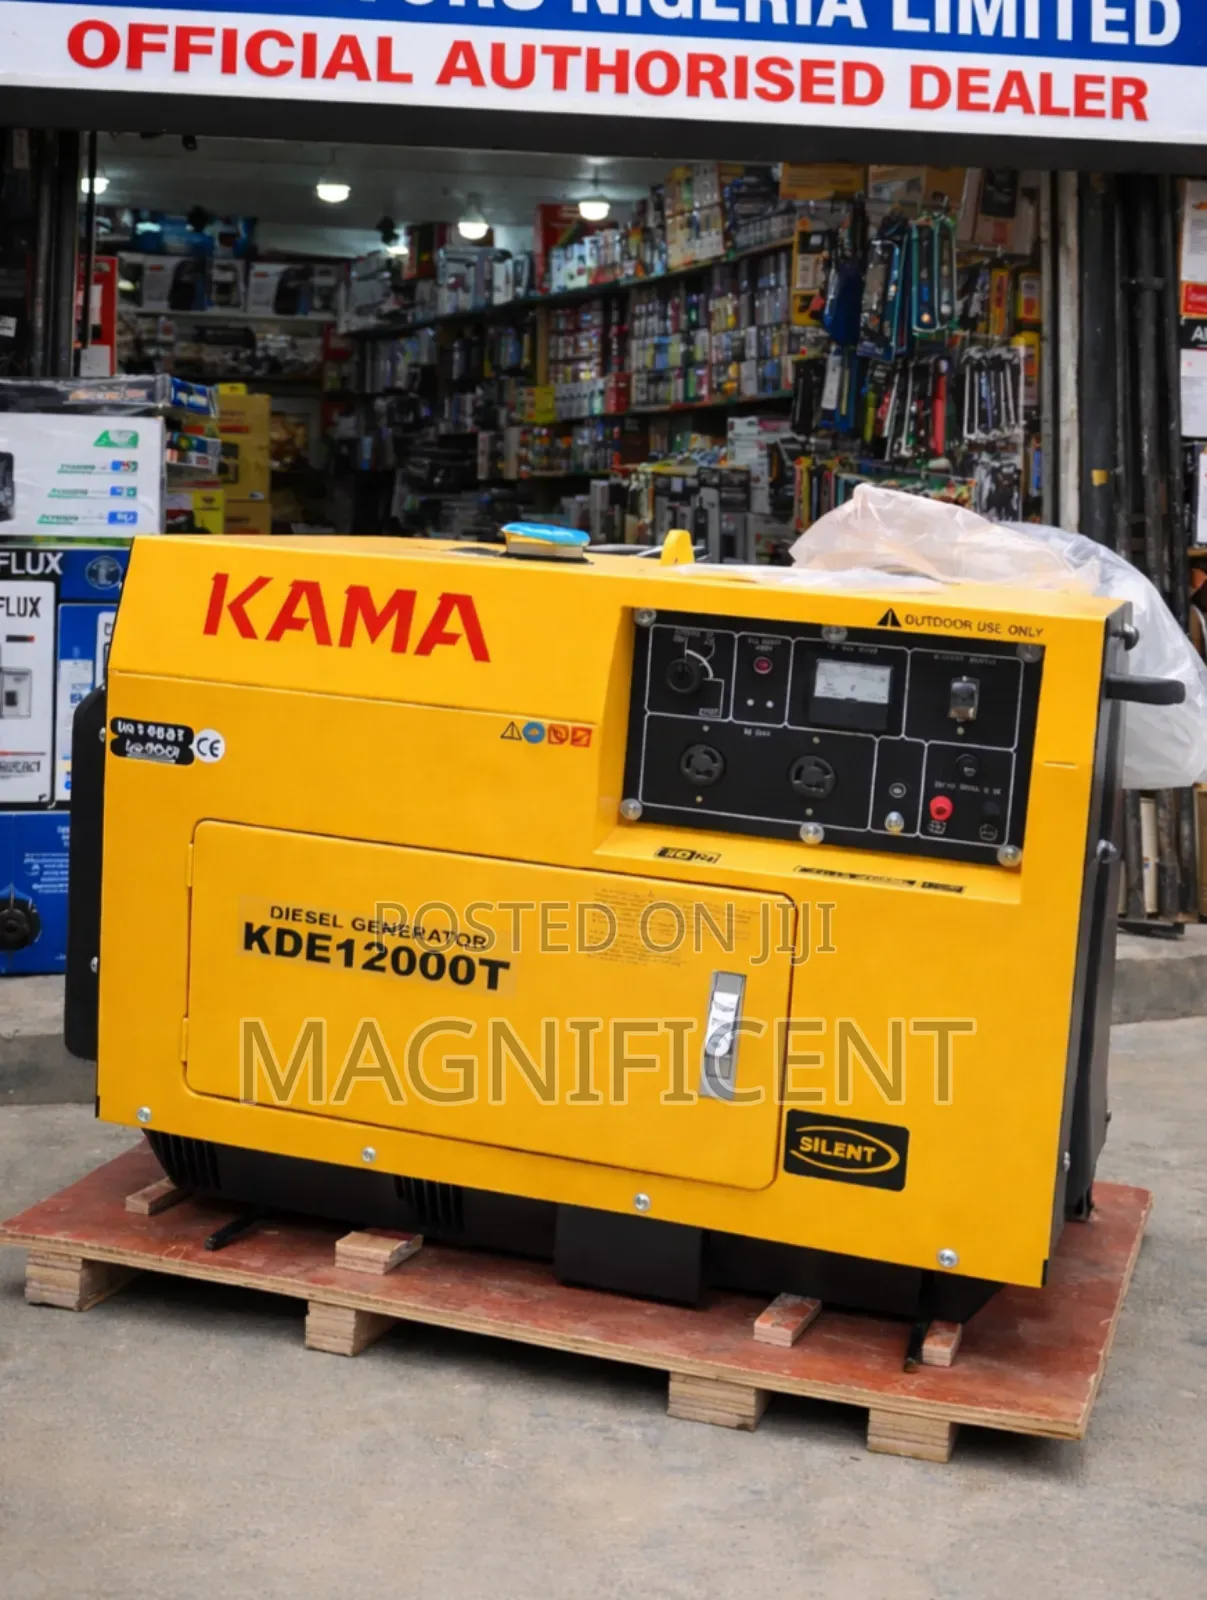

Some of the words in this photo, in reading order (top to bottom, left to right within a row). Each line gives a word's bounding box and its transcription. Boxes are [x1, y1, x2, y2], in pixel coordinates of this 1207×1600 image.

[892, 0, 1180, 47] LIMITED
[67, 19, 413, 85] OFFICIAL
[436, 40, 885, 106] AUTHORISED
[909, 64, 1149, 121] DEALER
[203, 572, 491, 663] KAMA
[905, 614, 973, 631] OUTDOOR
[977, 621, 1002, 635] USE
[1008, 624, 1044, 638] ONLY
[270, 905, 343, 929] DIESEL
[351, 917, 487, 950] GENERATOR
[243, 922, 510, 991] KDE12000T
[799, 1136, 877, 1163] SILENT
